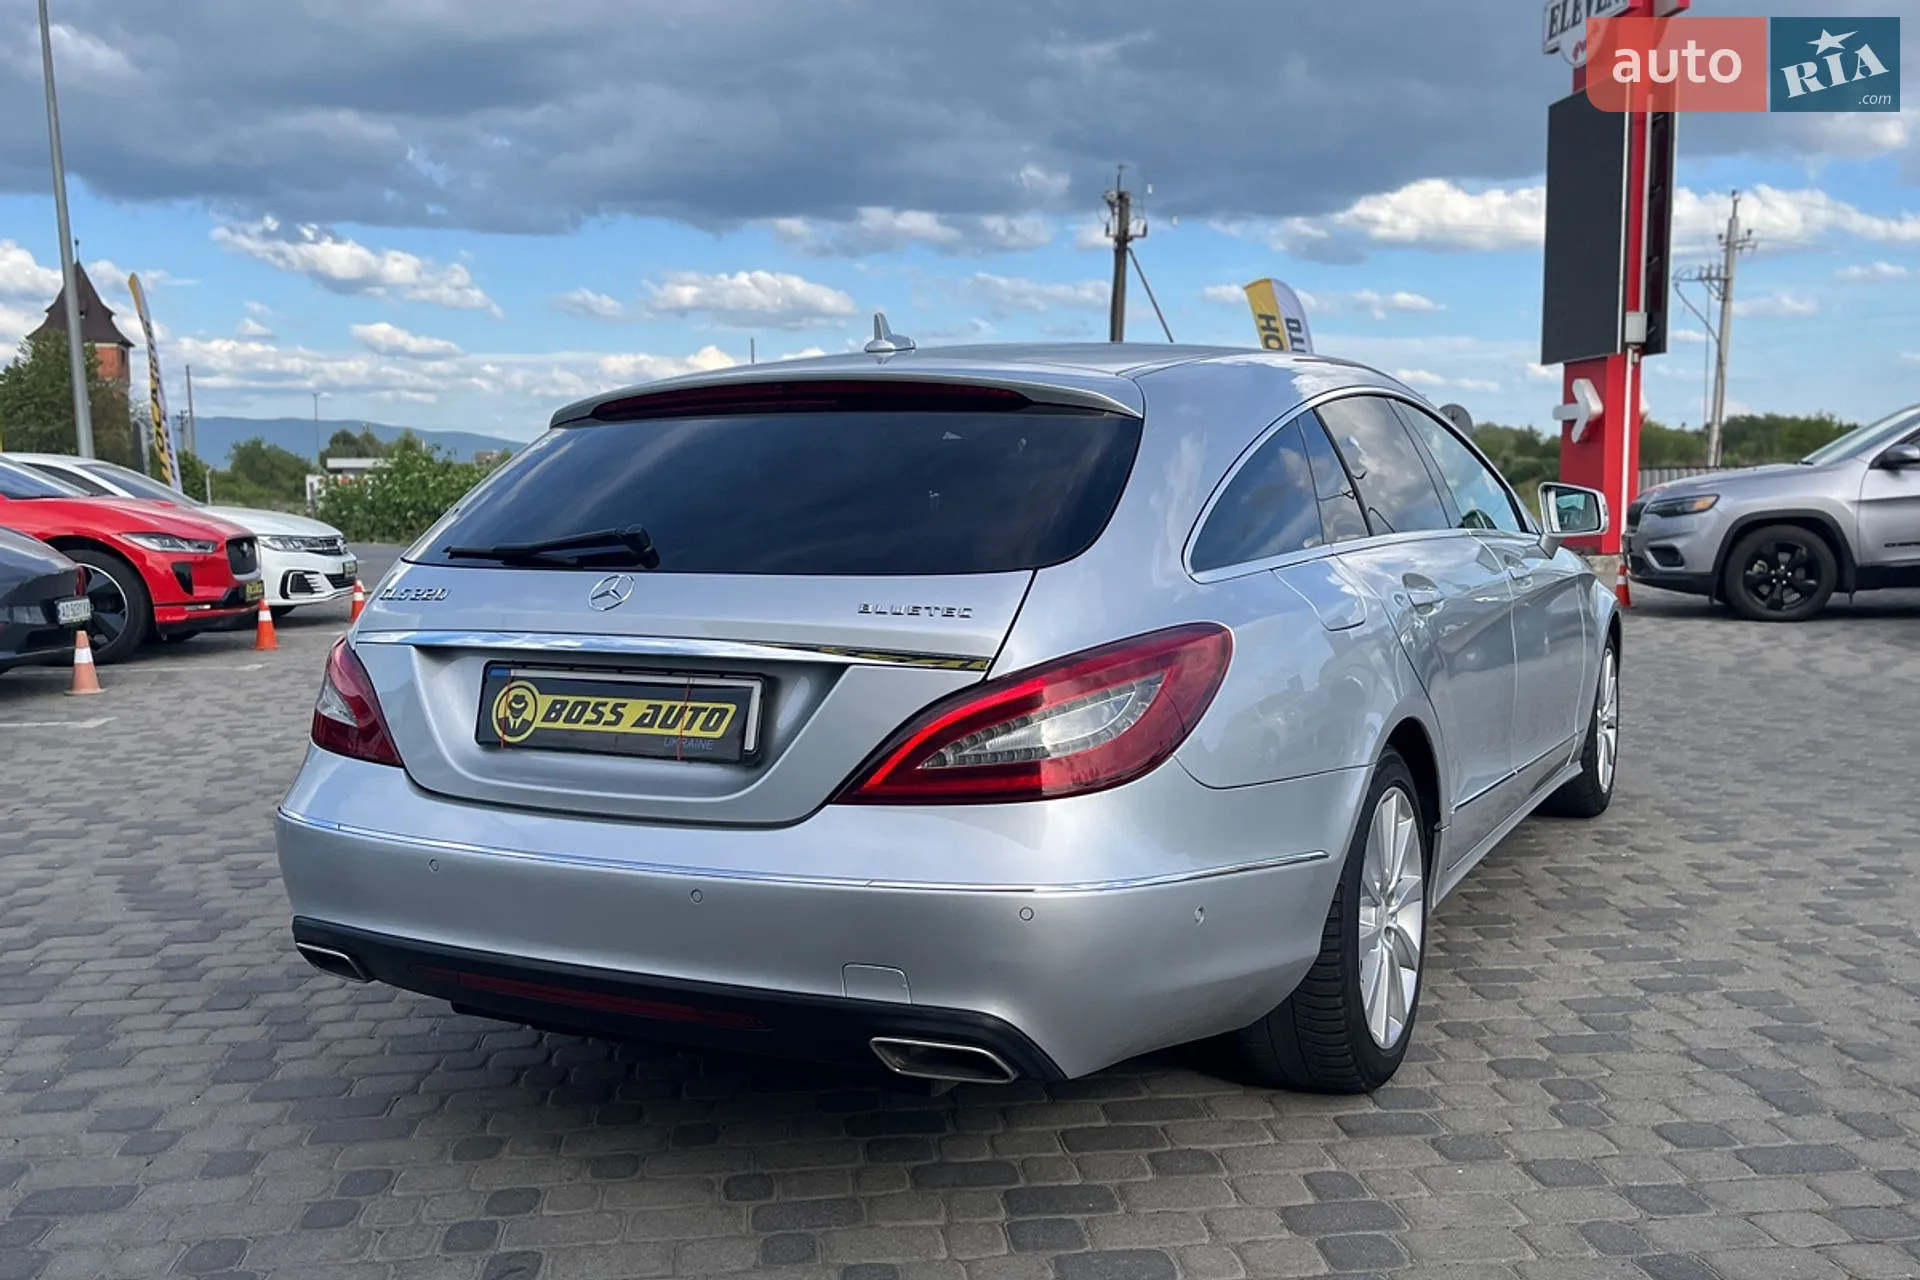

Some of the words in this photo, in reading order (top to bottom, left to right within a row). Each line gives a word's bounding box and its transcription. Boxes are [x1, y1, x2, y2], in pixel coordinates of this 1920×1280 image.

[857, 602, 973, 618] BLUETEC
[540, 699, 628, 726] BOSS
[630, 703, 729, 732] AUTO
[663, 736, 713, 750] UKRAINE
